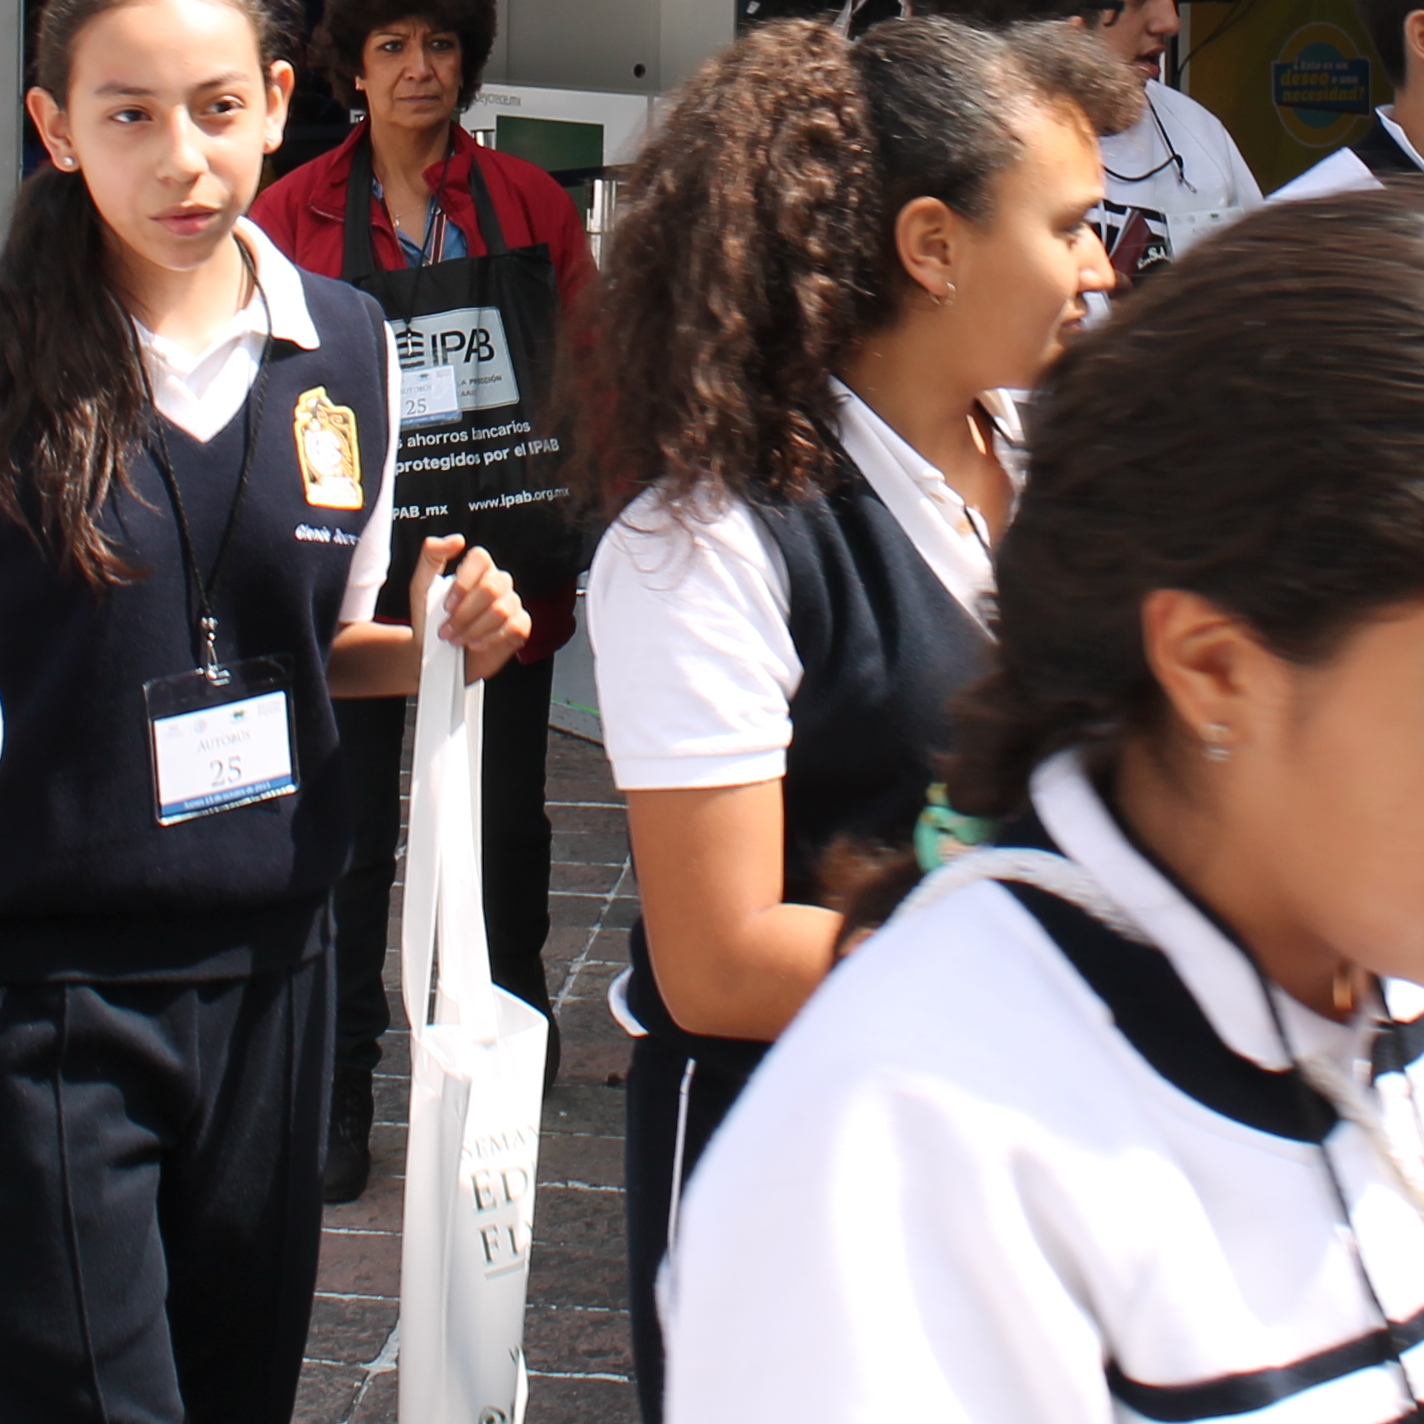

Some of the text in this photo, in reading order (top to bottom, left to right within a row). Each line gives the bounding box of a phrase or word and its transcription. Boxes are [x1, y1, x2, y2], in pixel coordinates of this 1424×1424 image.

[431, 328, 496, 367] IPAB
[405, 398, 428, 416] 25
[406, 430, 469, 448] ahorros
[395, 437, 561, 477] protegidos por el IPAB
[467, 486, 571, 513] www.ipab.org.mx
[208, 754, 243, 788] 25
